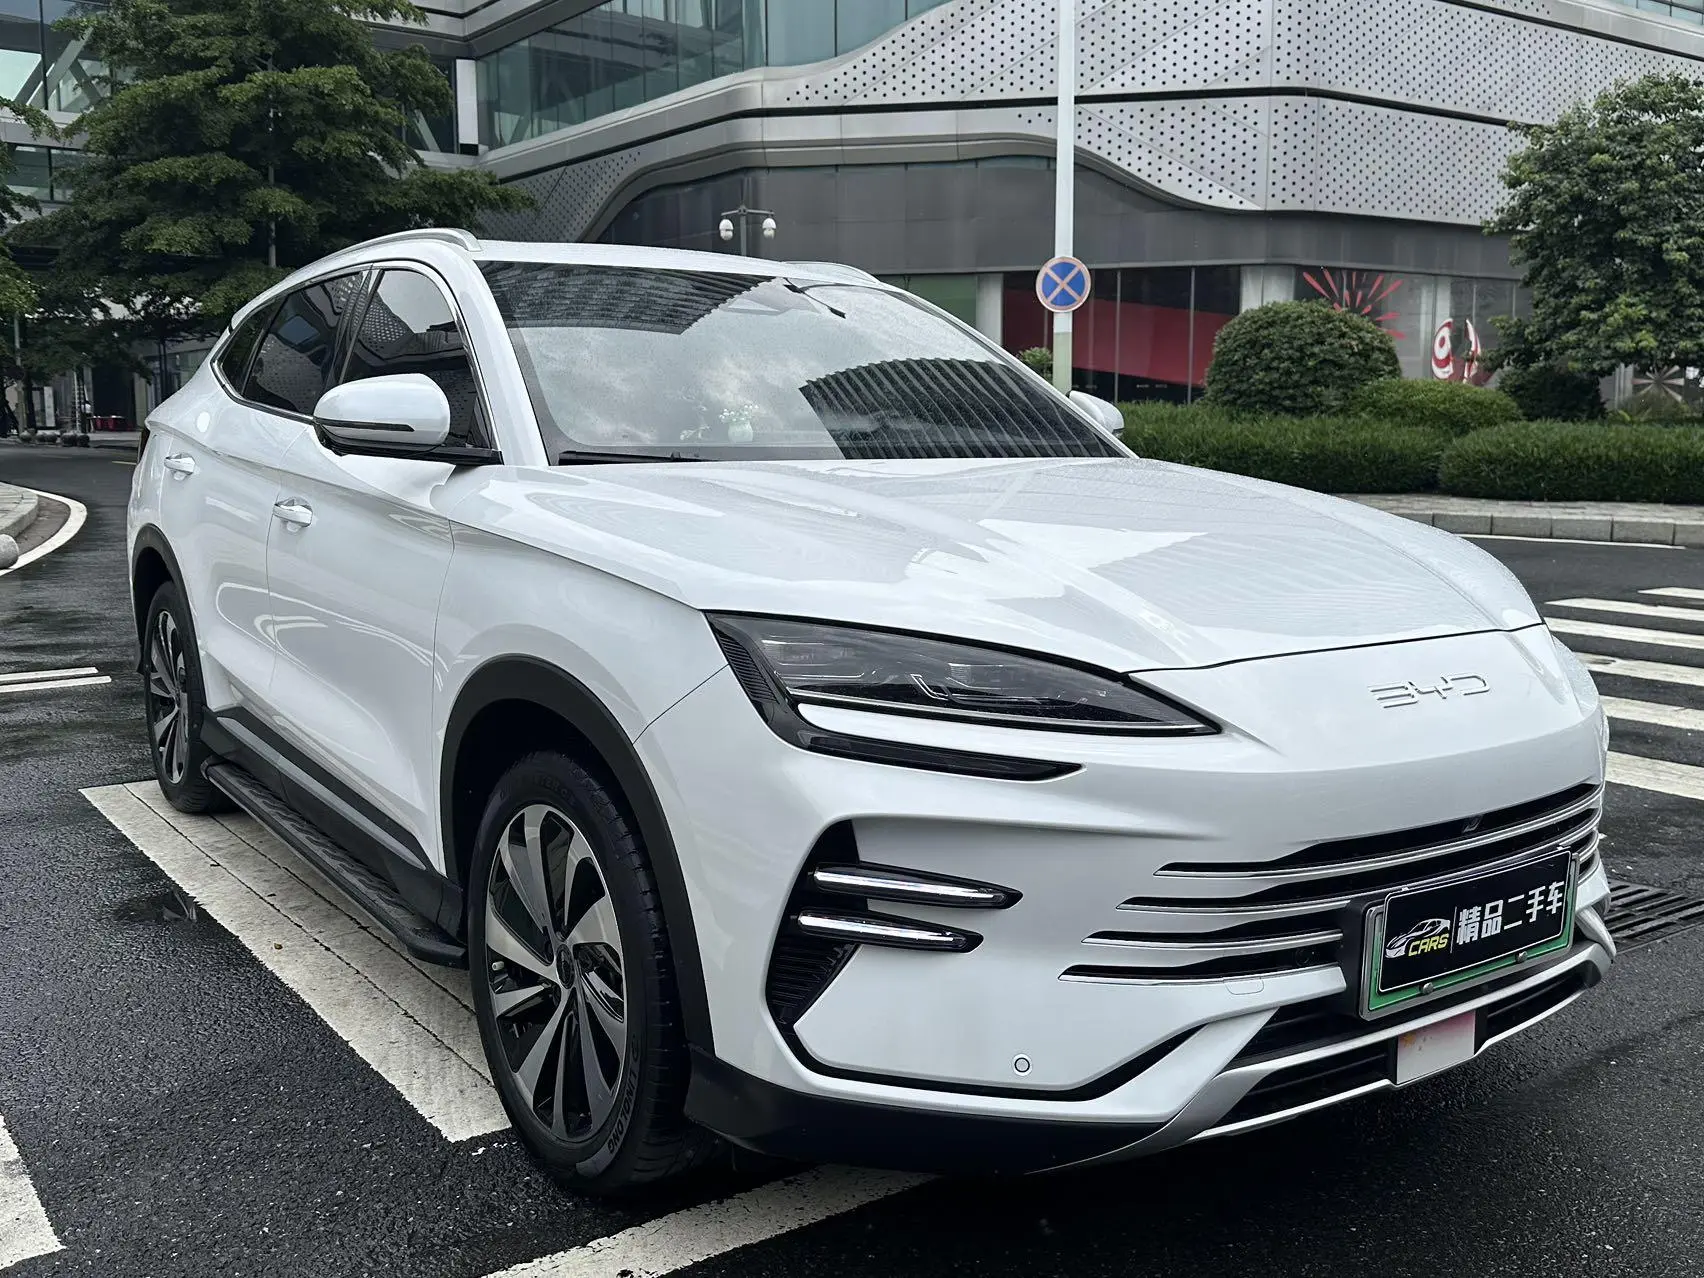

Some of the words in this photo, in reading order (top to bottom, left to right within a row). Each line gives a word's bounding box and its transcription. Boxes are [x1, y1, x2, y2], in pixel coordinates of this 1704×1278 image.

[1367, 672, 1490, 709] BYD
[1456, 880, 1565, 945] 精品二手车
[1407, 933, 1449, 957] CARS
